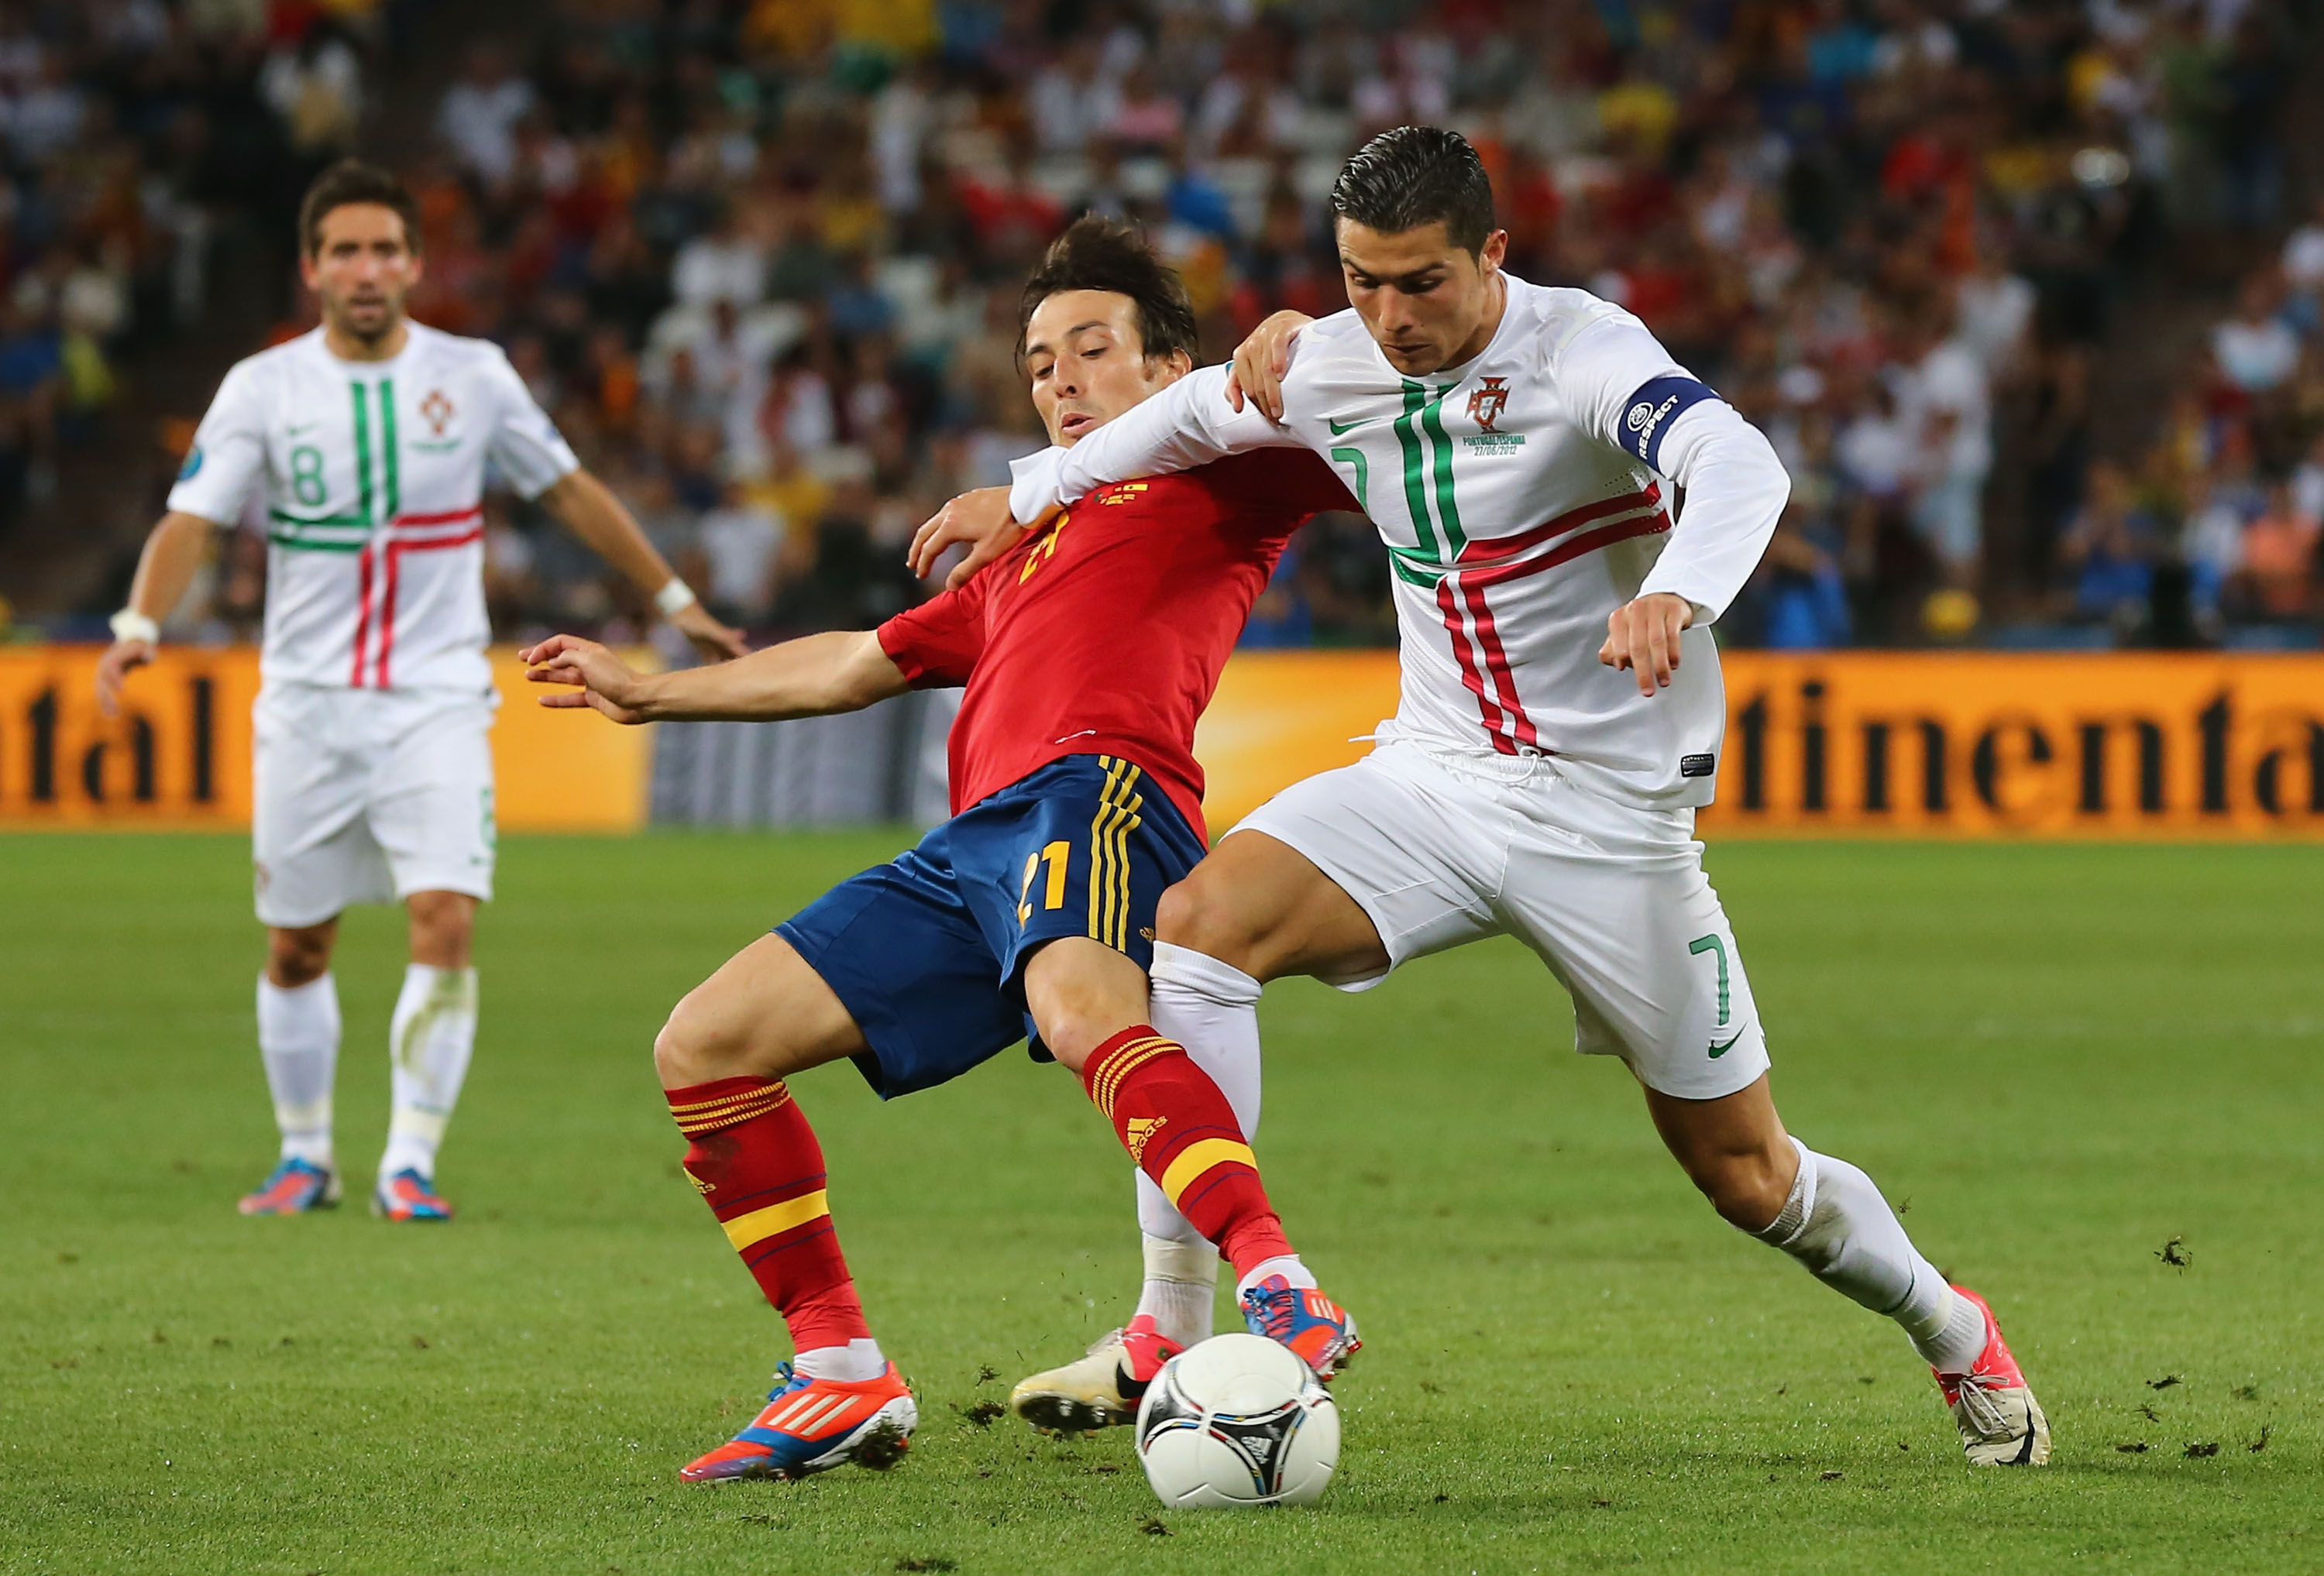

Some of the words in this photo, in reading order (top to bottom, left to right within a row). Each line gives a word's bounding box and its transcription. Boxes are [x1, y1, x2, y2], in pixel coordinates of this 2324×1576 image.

[1638, 394, 1679, 459] RESPECT
[290, 445, 327, 506] 8
[1331, 448, 1370, 517] 7
[29, 675, 215, 804] tal
[1017, 840, 1071, 931] 21
[1689, 933, 1730, 1025] 7
